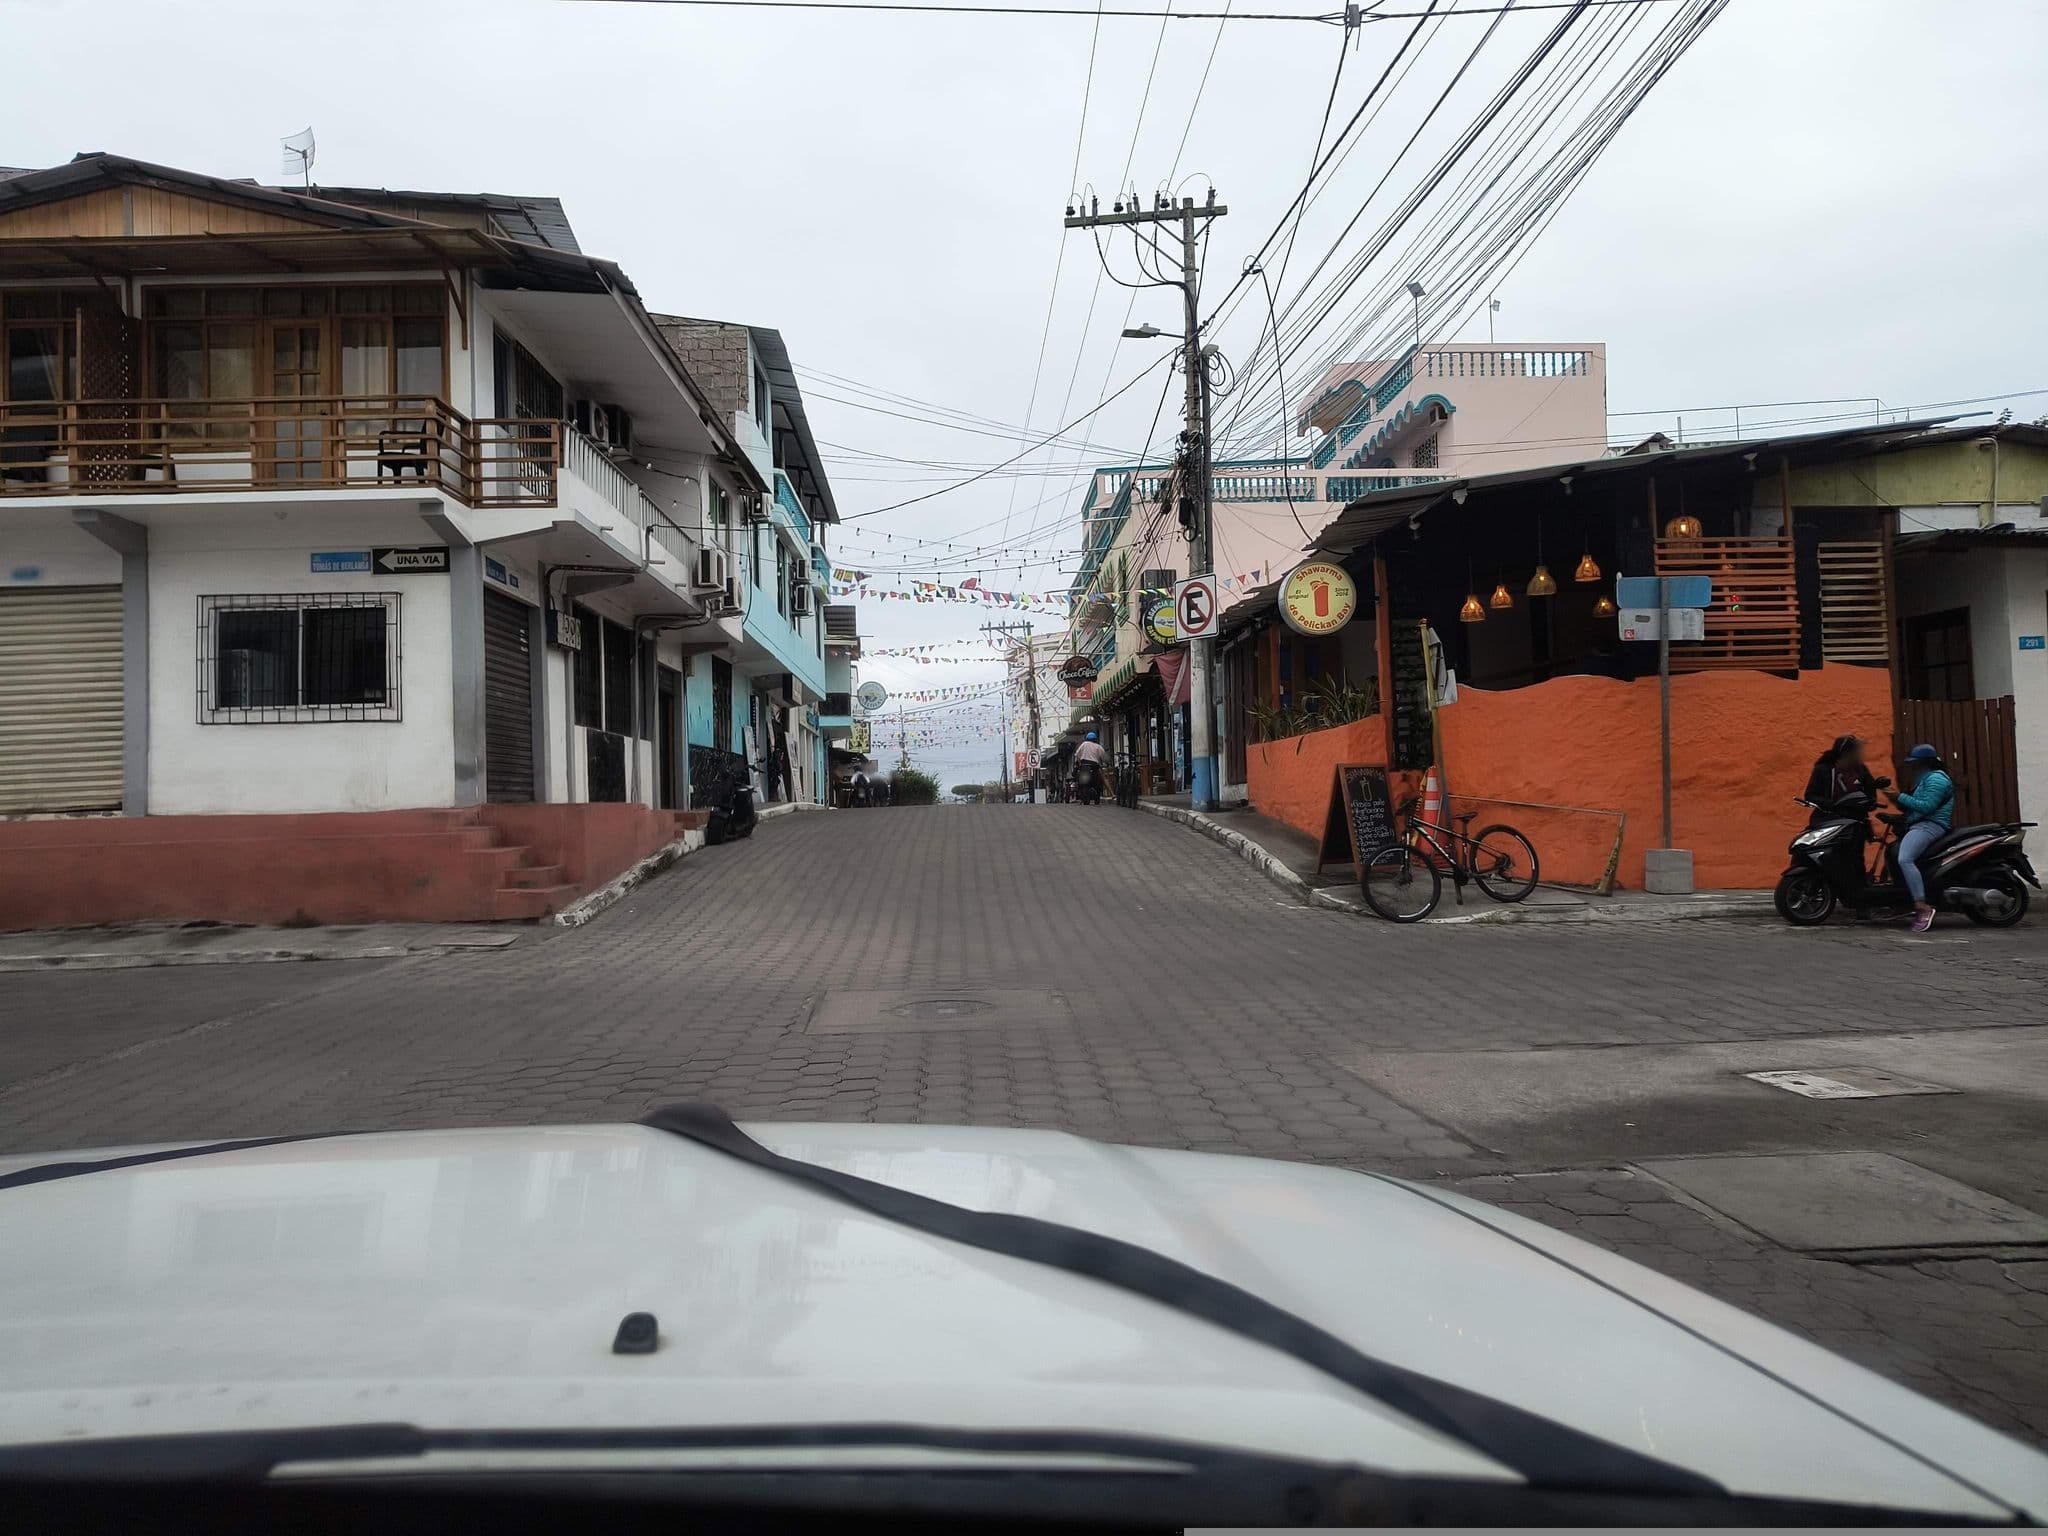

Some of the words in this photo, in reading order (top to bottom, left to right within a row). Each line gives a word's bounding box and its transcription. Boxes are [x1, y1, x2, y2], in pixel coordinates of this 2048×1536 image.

[333, 561, 340, 571] DE
[397, 555, 420, 565] UNA
[423, 555, 440, 564] VIA
[1296, 566, 1343, 581] Shawarma
[1146, 600, 1168, 621] AGENCIA
[1289, 604, 1299, 617] de
[1298, 615, 1338, 630] Pelickan
[1337, 603, 1352, 621] Bay
